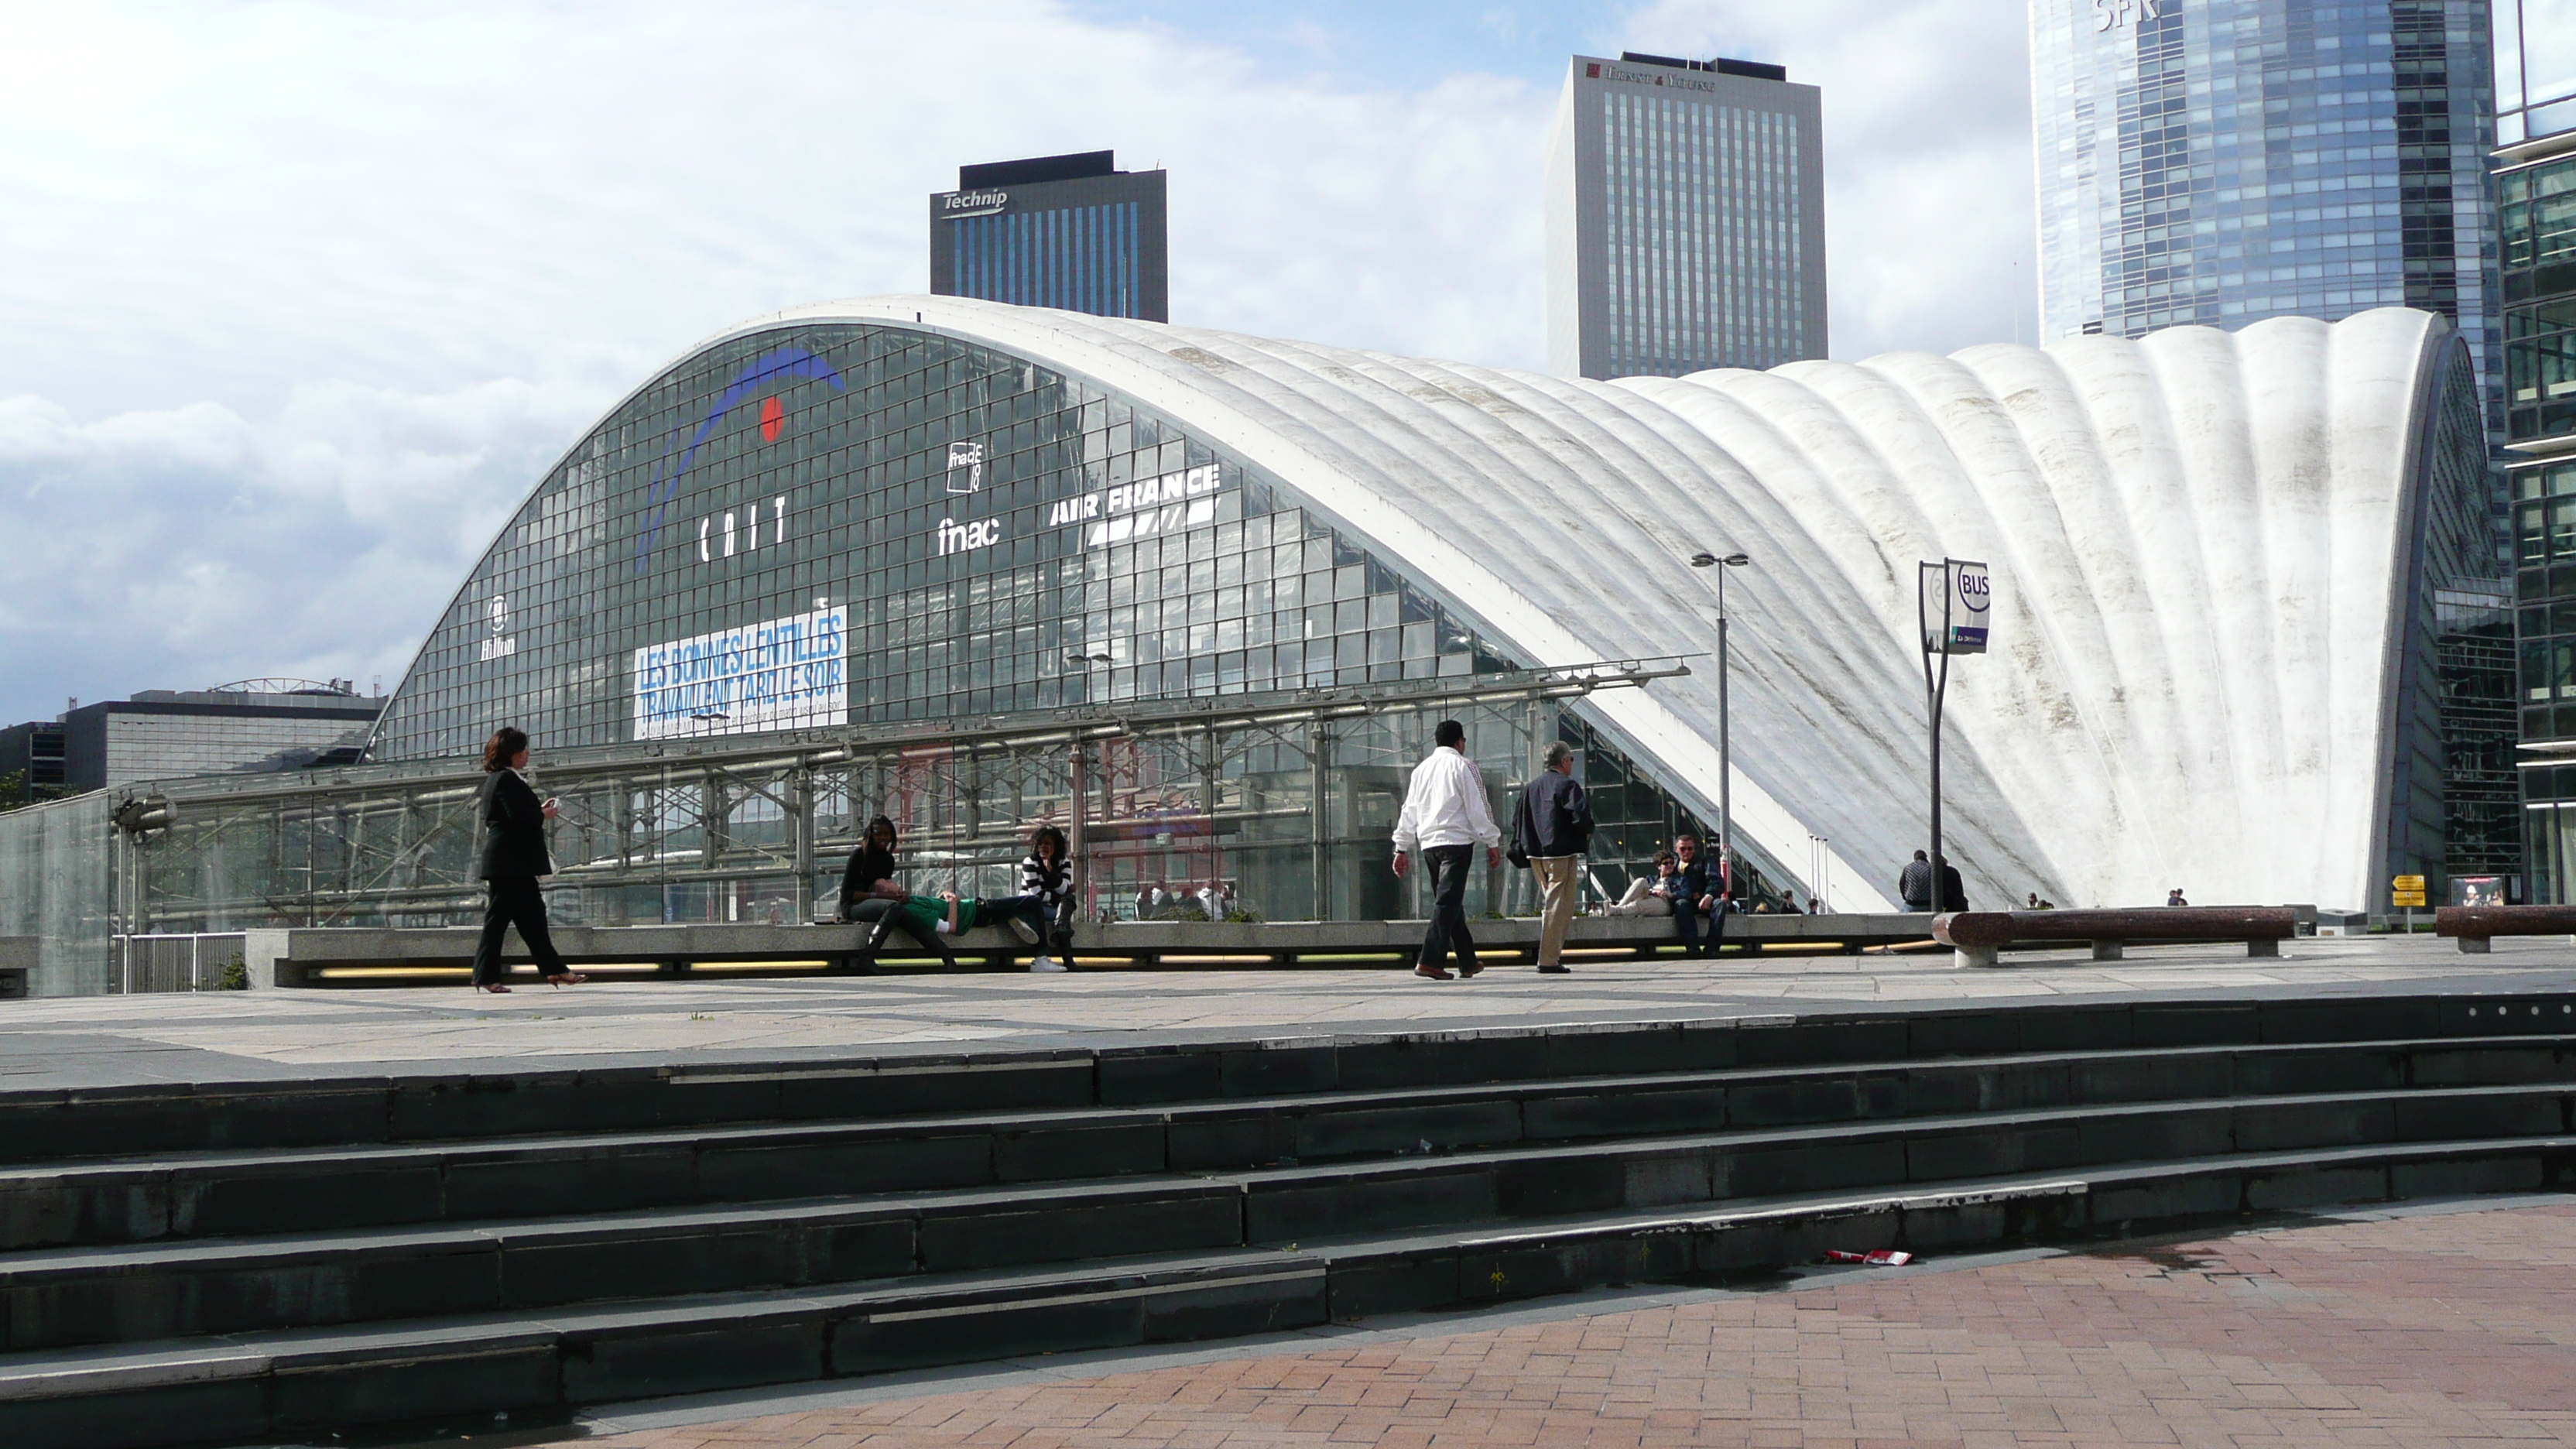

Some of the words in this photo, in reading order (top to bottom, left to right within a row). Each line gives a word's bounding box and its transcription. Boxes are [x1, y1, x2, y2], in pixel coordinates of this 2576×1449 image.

[1607, 65, 1653, 84] ERNST
[1655, 75, 1664, 87] &
[1667, 73, 1716, 92] YOUNG
[943, 188, 1007, 207] Technip
[1050, 494, 1099, 526] AIR
[1108, 464, 1220, 513] FRANCE
[938, 518, 999, 556] fnac
[1962, 574, 1990, 596] BUS
[480, 634, 516, 661] Hilton
[640, 651, 668, 690] LES
[672, 635, 742, 685] BONNES
[746, 614, 841, 671] LENTILLES
[640, 677, 734, 724] TRAVAILLENT
[737, 670, 776, 707] TARD
[782, 666, 800, 701] LE
[804, 658, 841, 698] SOIR
[779, 706, 797, 718] matn
[800, 701, 827, 720] jusu'au
